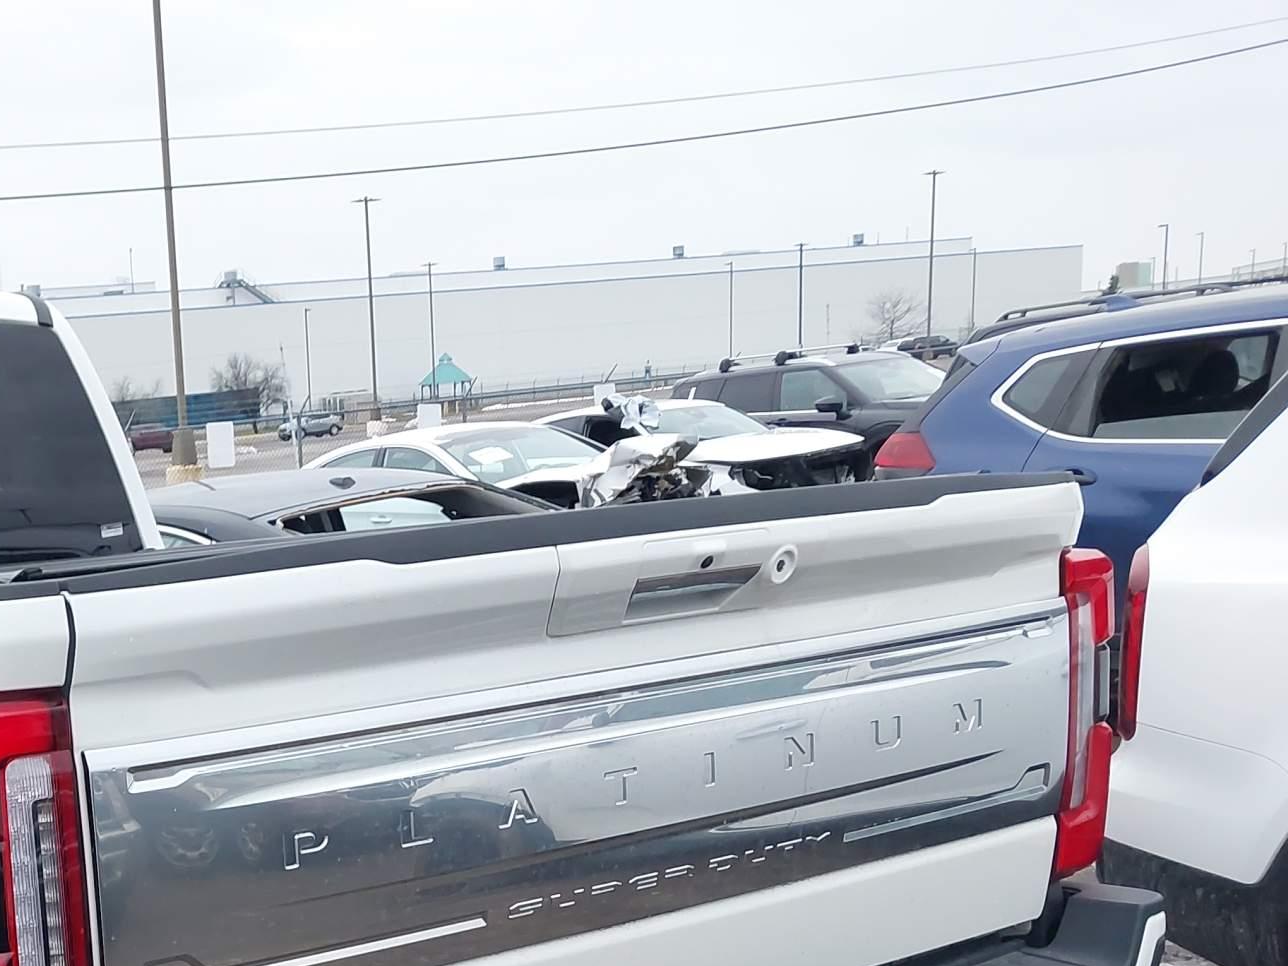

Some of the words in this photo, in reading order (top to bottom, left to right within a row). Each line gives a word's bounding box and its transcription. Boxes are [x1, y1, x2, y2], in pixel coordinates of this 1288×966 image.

[282, 696, 983, 870] PLATINUM
[508, 863, 696, 919] SUPER
[708, 831, 831, 872] DUTY
